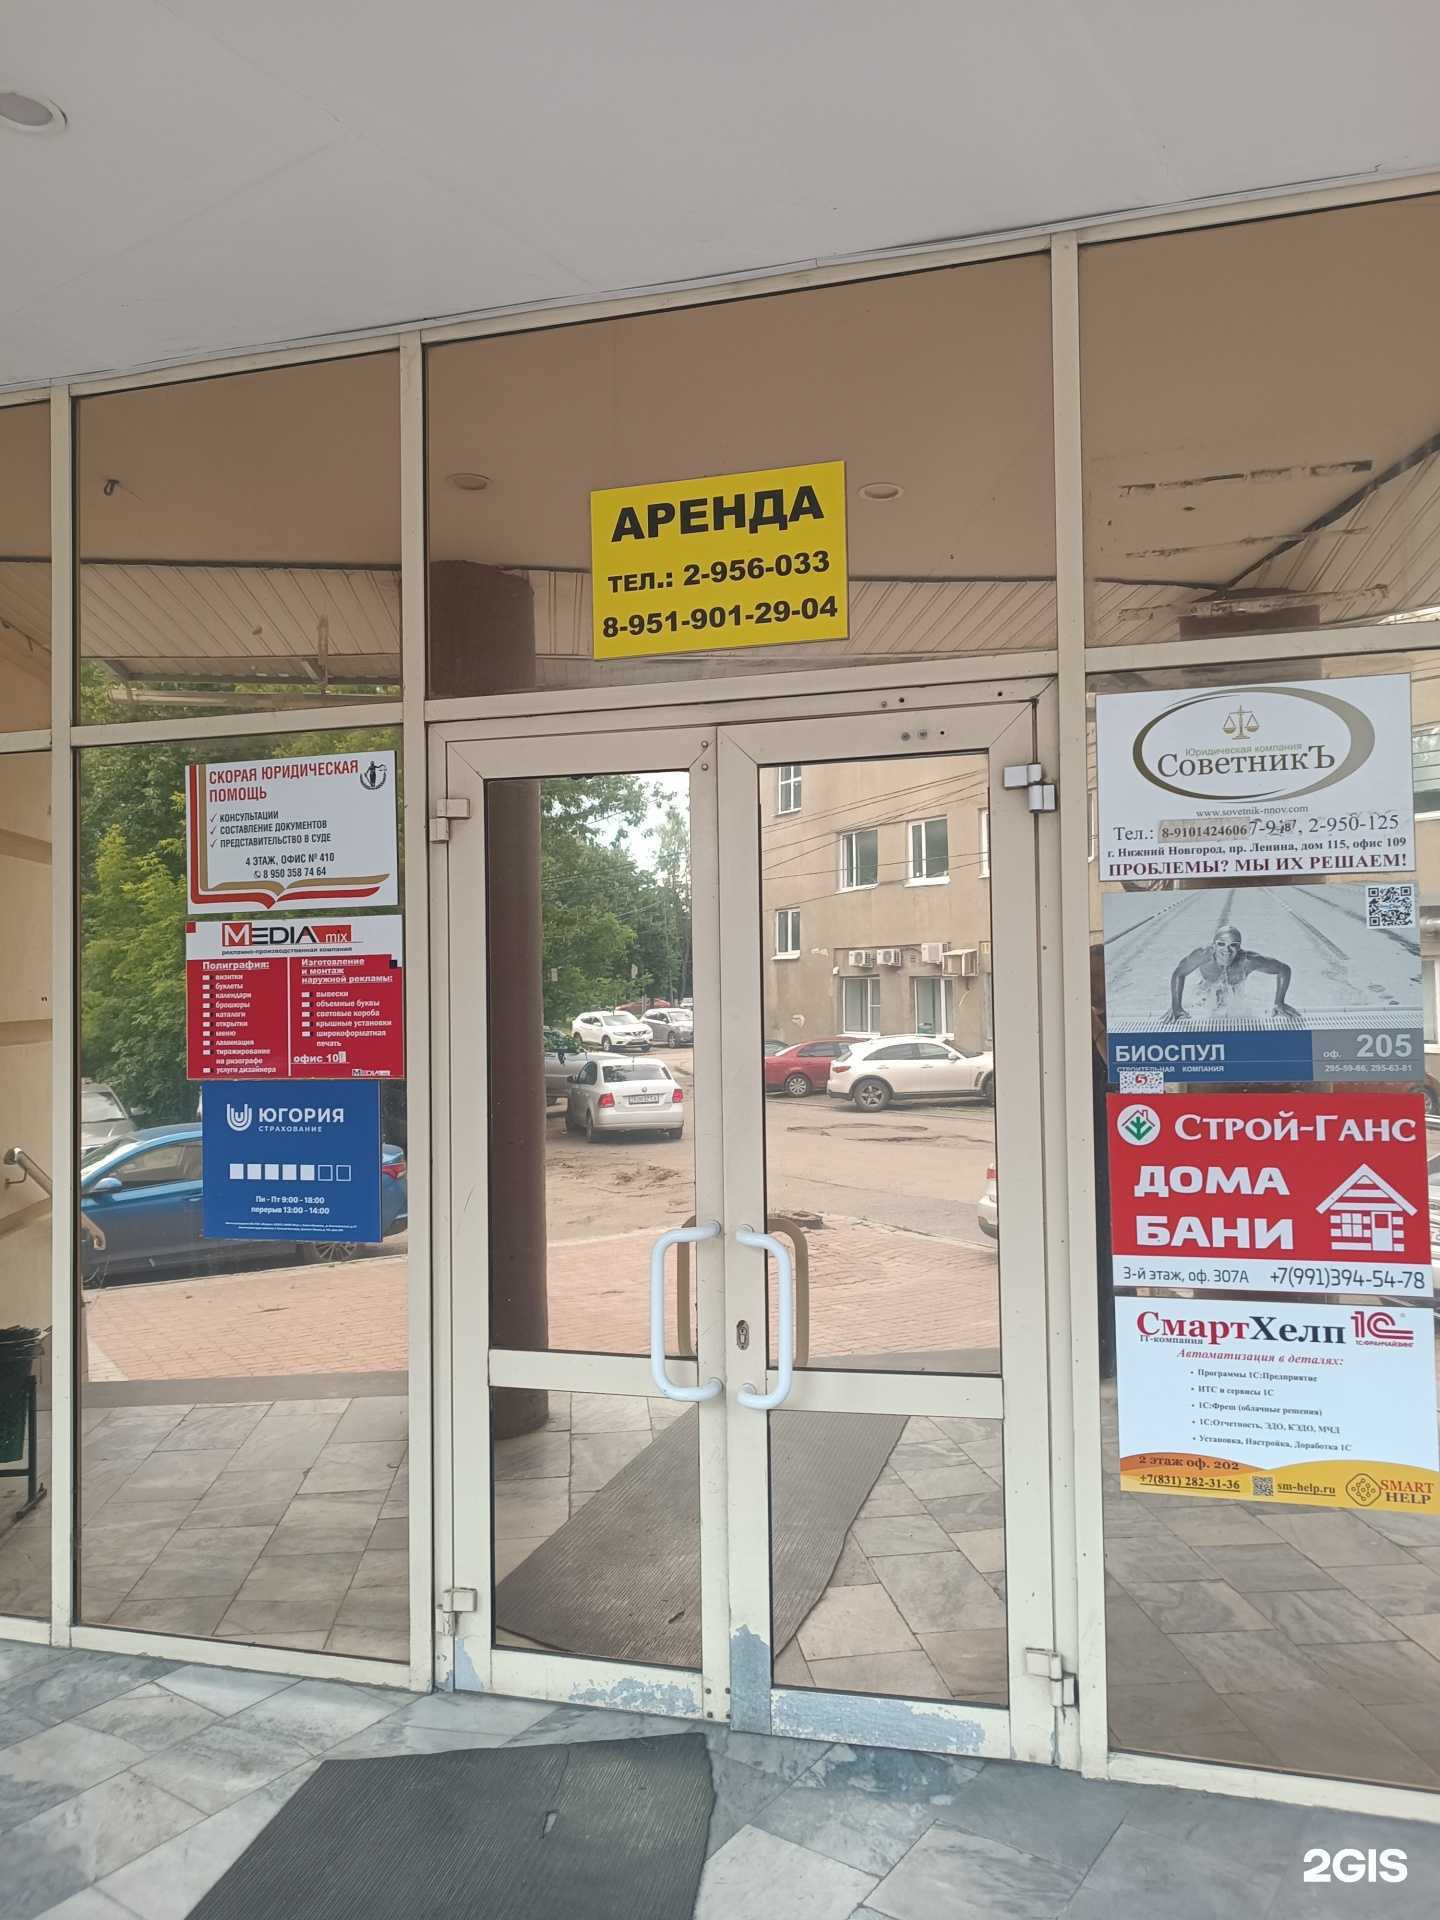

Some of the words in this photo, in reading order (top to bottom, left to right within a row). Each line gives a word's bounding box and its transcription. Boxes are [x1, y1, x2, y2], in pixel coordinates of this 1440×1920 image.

[611, 485, 825, 542] АРЕНДА
[608, 572, 673, 593] ТЕЛ.:
[683, 550, 830, 585] 2-956-033
[603, 596, 838, 638] 8-951-901-29-04
[1185, 746, 1252, 757] Юридическая
[1254, 743, 1302, 753] компания
[1157, 745, 1335, 778] СоветникЪ
[209, 768, 257, 784] СКОРАЯ
[262, 760, 358, 780] ЮРИДИЧЕСКАЯ
[209, 786, 267, 802] ПОМОЩЬ
[220, 810, 279, 822] КОНСУЛЬТАЦИИ
[1195, 805, 1309, 818] www.sovetnik-nnov.com
[220, 823, 273, 834] СОСТАВЛЕНИЕ
[275, 820, 327, 832] ДОКУМЕНТОВ
[1113, 826, 1154, 841] Тел.:
[1161, 825, 1247, 838] 8-9101424606
[1308, 814, 1400, 833] 2-950-125
[220, 834, 302, 848] ПРЕДСТАВИТЕЛЬСТВО
[304, 835, 309, 843] В
[311, 833, 331, 843] СУДЕ
[1118, 847, 1165, 857] Нижний
[1168, 845, 1226, 856] Новгород,
[1229, 844, 1247, 855] пр.
[1250, 842, 1298, 853] Ленина,
[1301, 842, 1323, 851] дом
[1327, 839, 1350, 849] 115,
[1353, 838, 1383, 851] офис
[1386, 837, 1407, 847] 109
[245, 857, 250, 866] 4
[253, 855, 279, 866] ЭТАЖ,
[281, 853, 306, 864] ОФИС
[319, 852, 335, 862] 410
[1109, 859, 1229, 876] ПРОБЛЕМЫ?
[1235, 858, 1270, 872] МЫ
[1276, 856, 1303, 870] ИХ
[1310, 853, 1407, 869] РЕШАЕМ!
[263, 870, 268, 878] 8
[270, 869, 285, 878] 950
[287, 868, 302, 877] 358
[304, 867, 314, 876] 74
[316, 866, 326, 876] 64
[224, 924, 318, 946] MEDIA
[325, 930, 348, 943] mix
[202, 961, 270, 971] Полиграфия:
[302, 958, 365, 967] Изготовление
[302, 976, 347, 985] наружной
[1115, 1044, 1225, 1061] БИОСПУЛ
[1323, 1049, 1342, 1058] оф.
[1356, 1033, 1412, 1057] 205
[293, 1054, 323, 1064] офис
[1182, 1065, 1225, 1073] КОМПАНИЯ
[259, 1107, 344, 1123] ЮГОРИЯ
[258, 1125, 323, 1133] СТРАХОВАНИЕ
[1134, 1165, 1291, 1198] ДОМА
[1135, 1215, 1294, 1250] БАНИ
[1123, 1265, 1146, 1280] 3-й
[1149, 1268, 1185, 1283] этаж,
[1188, 1267, 1210, 1284] оф.
[1213, 1269, 1249, 1283] 307А
[1269, 1267, 1425, 1290] +7(991)394-54-78
[1136, 1311, 1347, 1345] СмартХелп
[1177, 1348, 1275, 1362] Автоматизация
[1288, 1354, 1344, 1366] деталях:
[1198, 1368, 1247, 1378] Программы
[1249, 1371, 1318, 1382] 1С:Предприятие
[1198, 1385, 1218, 1393] ИТС
[1226, 1388, 1261, 1396] сервисы
[1199, 1401, 1236, 1411] 1С:Фреш
[1282, 1407, 1323, 1417] решения)
[1294, 1440, 1338, 1451] Доработка
[1138, 1456, 1147, 1464] 2
[1150, 1457, 1183, 1466] этаж
[1186, 1458, 1210, 1470] оф.
[1214, 1461, 1239, 1470] 202
[1140, 1474, 1181, 1487] +7(831)
[1185, 1477, 1240, 1490] 282-31-36
[1277, 1480, 1336, 1495] sm-help.ru
[1380, 1479, 1435, 1494] SMART
[1386, 1491, 1432, 1504] HELP
